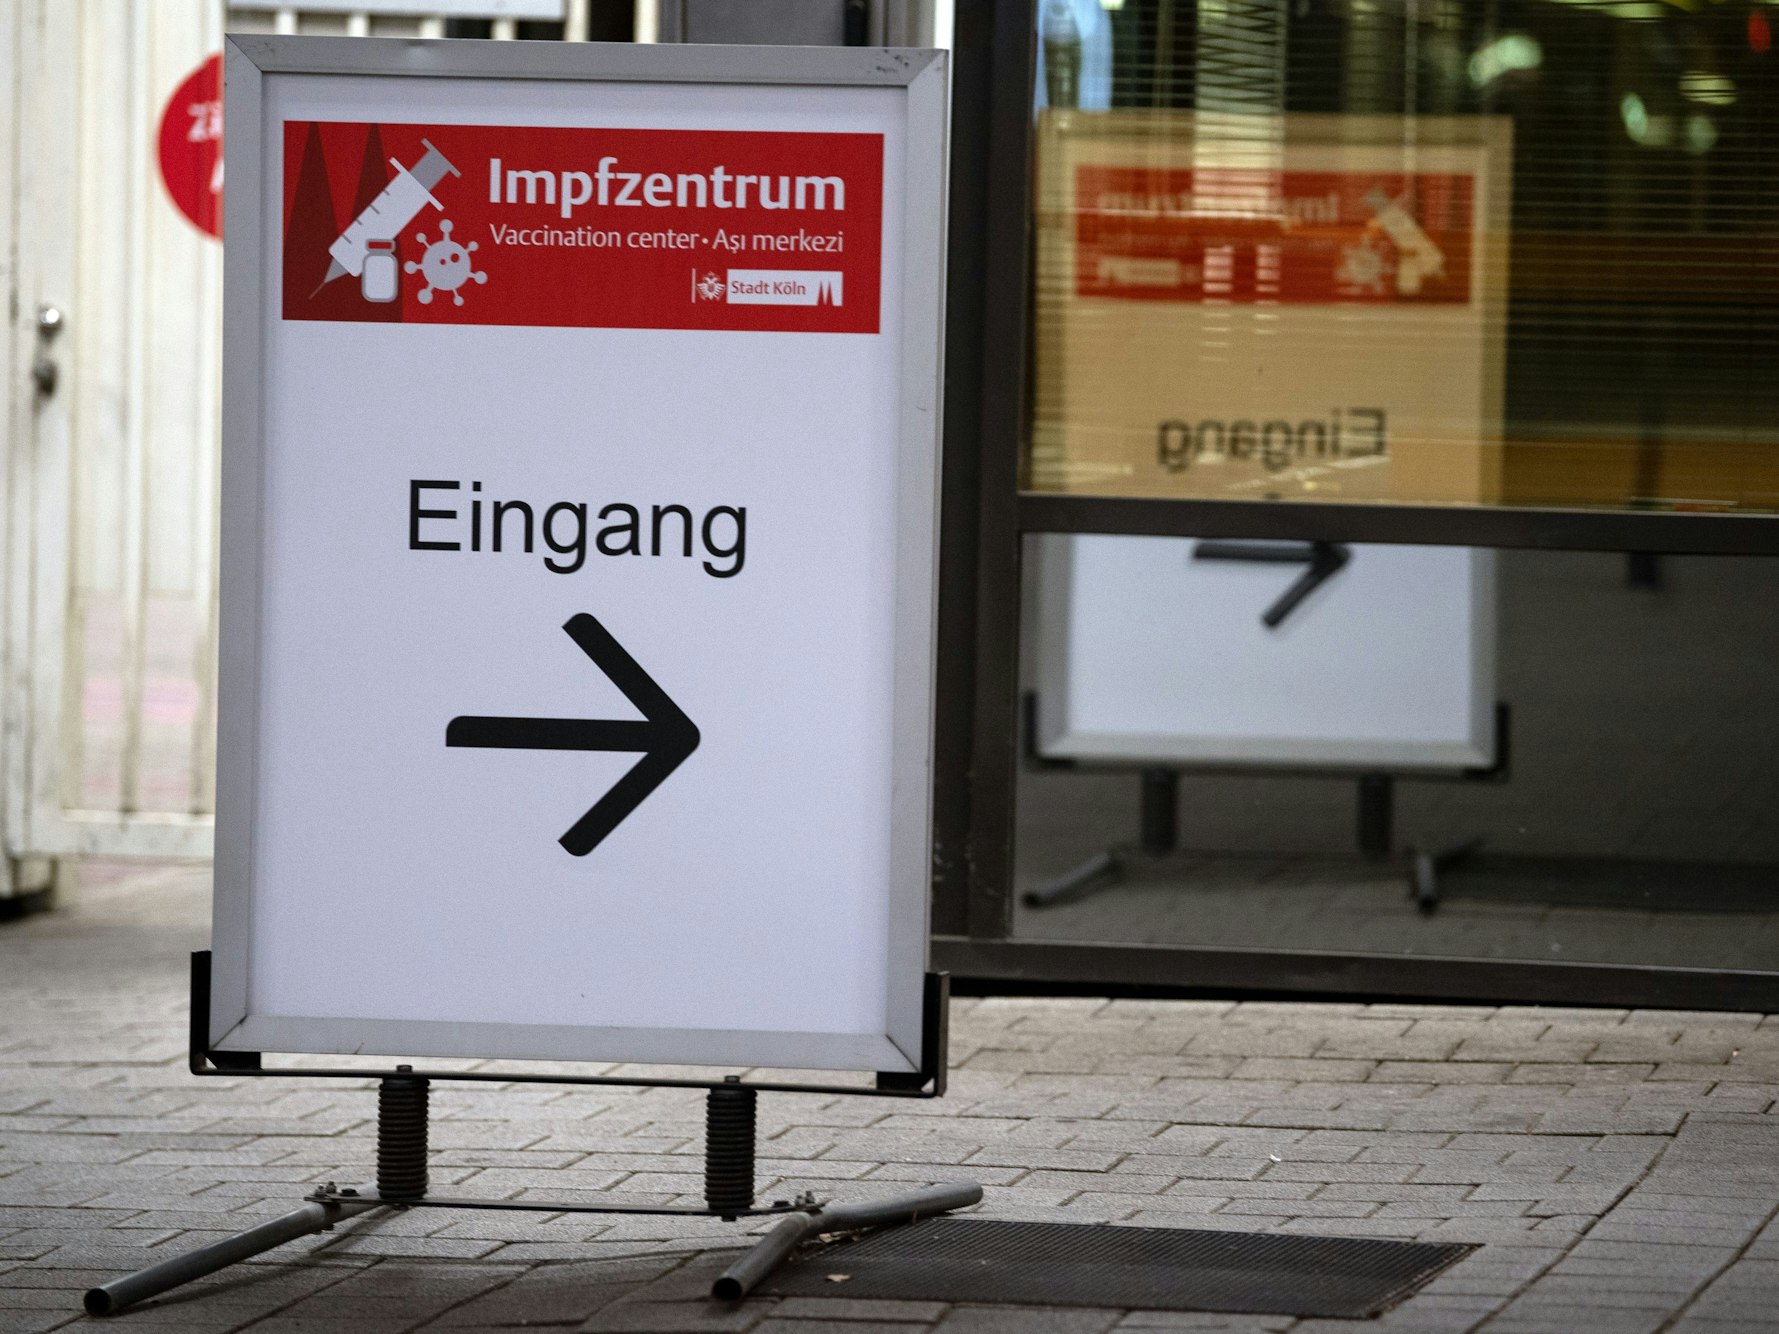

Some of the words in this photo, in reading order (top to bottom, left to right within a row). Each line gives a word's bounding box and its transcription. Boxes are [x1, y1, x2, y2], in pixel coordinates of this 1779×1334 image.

[489, 157, 845, 218] Impfzentrum
[489, 223, 621, 249] Vaccination
[627, 229, 699, 250] center
[712, 229, 746, 254] Aşı
[752, 229, 844, 252] merkezi
[731, 280, 770, 295] Stadt
[774, 281, 806, 296] Köln
[409, 479, 747, 579] Eingang
